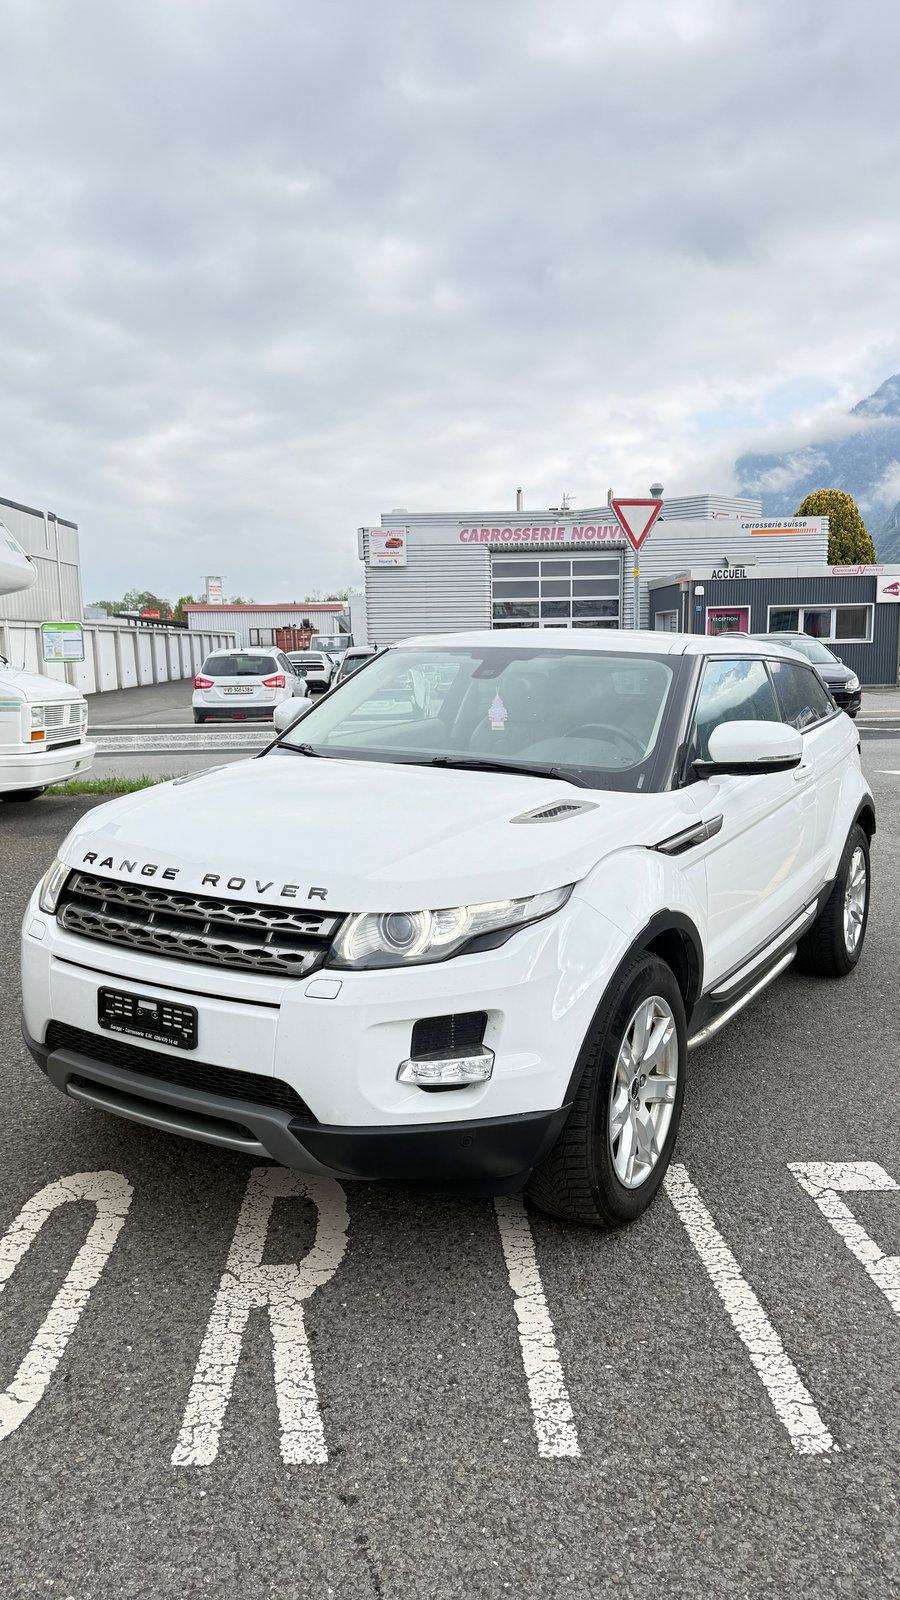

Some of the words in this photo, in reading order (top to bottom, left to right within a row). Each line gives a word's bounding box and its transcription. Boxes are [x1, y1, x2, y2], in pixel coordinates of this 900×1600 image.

[741, 521, 782, 529] carrosserie
[783, 519, 807, 528] suisse
[459, 527, 566, 543] CARROSSERIE
[711, 569, 747, 579] ACCUEIL
[82, 851, 180, 881] RANGE
[201, 873, 329, 901] ROVER
[110, 1024, 122, 1032] Garage
